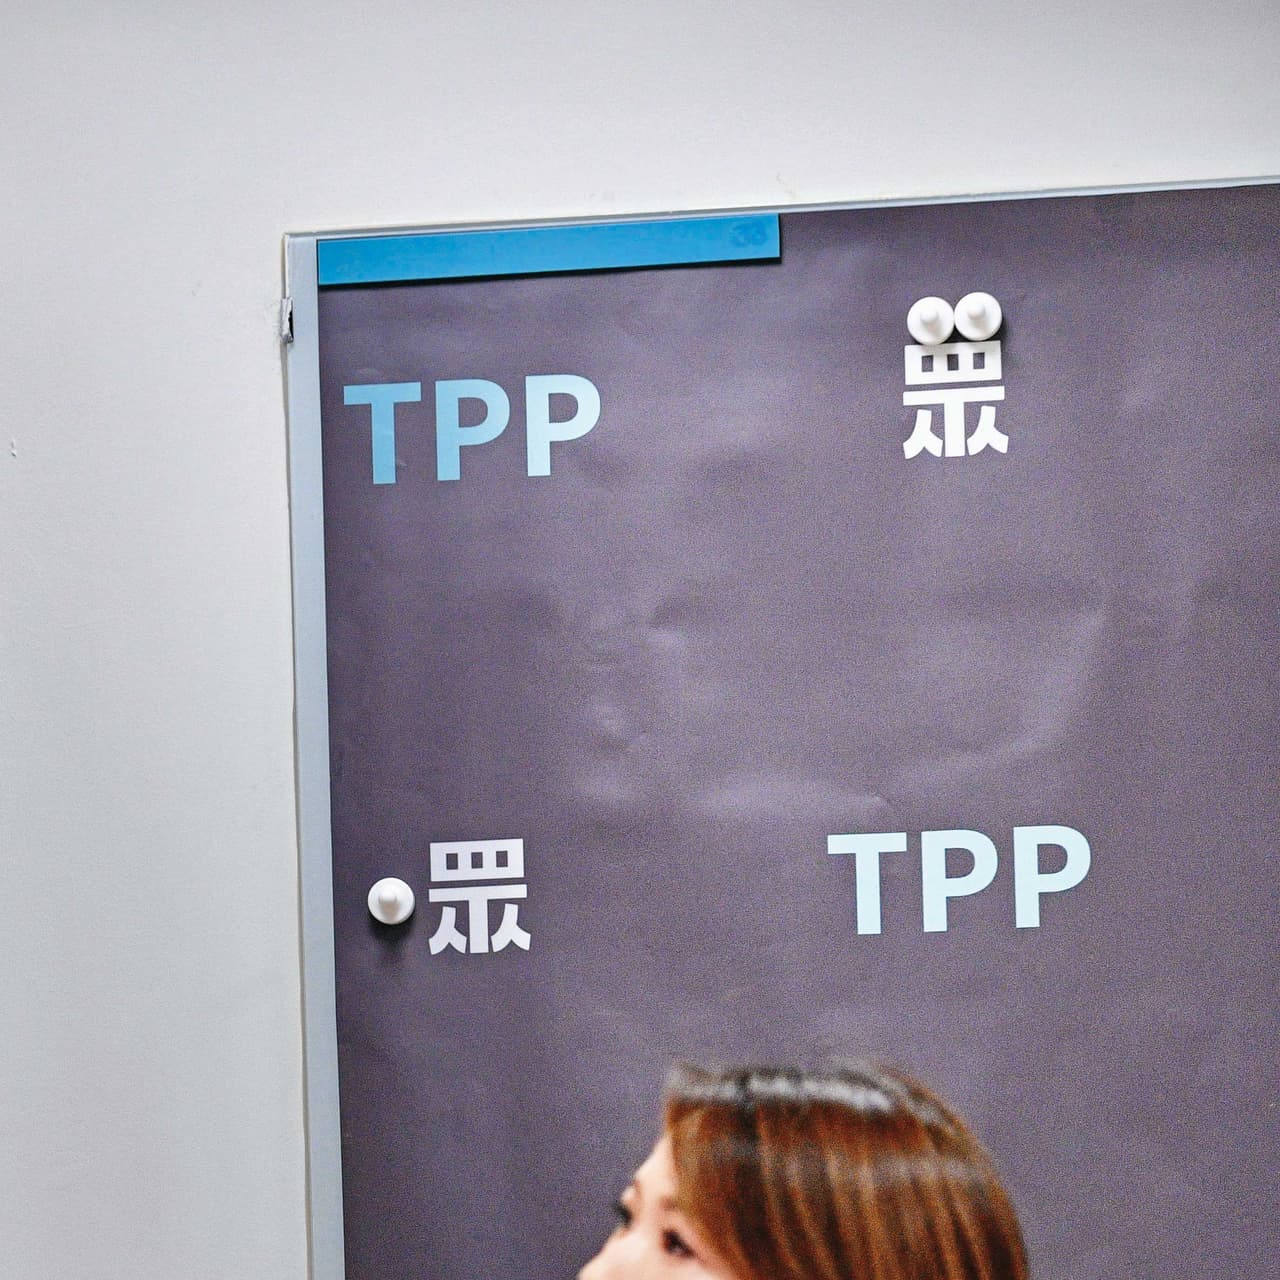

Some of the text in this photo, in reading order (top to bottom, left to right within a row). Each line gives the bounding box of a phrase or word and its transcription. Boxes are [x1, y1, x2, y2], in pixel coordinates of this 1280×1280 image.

[343, 373, 602, 484] TPP
[902, 339, 1010, 460] 眾
[428, 838, 532, 955] 眾
[826, 824, 1093, 936] TPP
